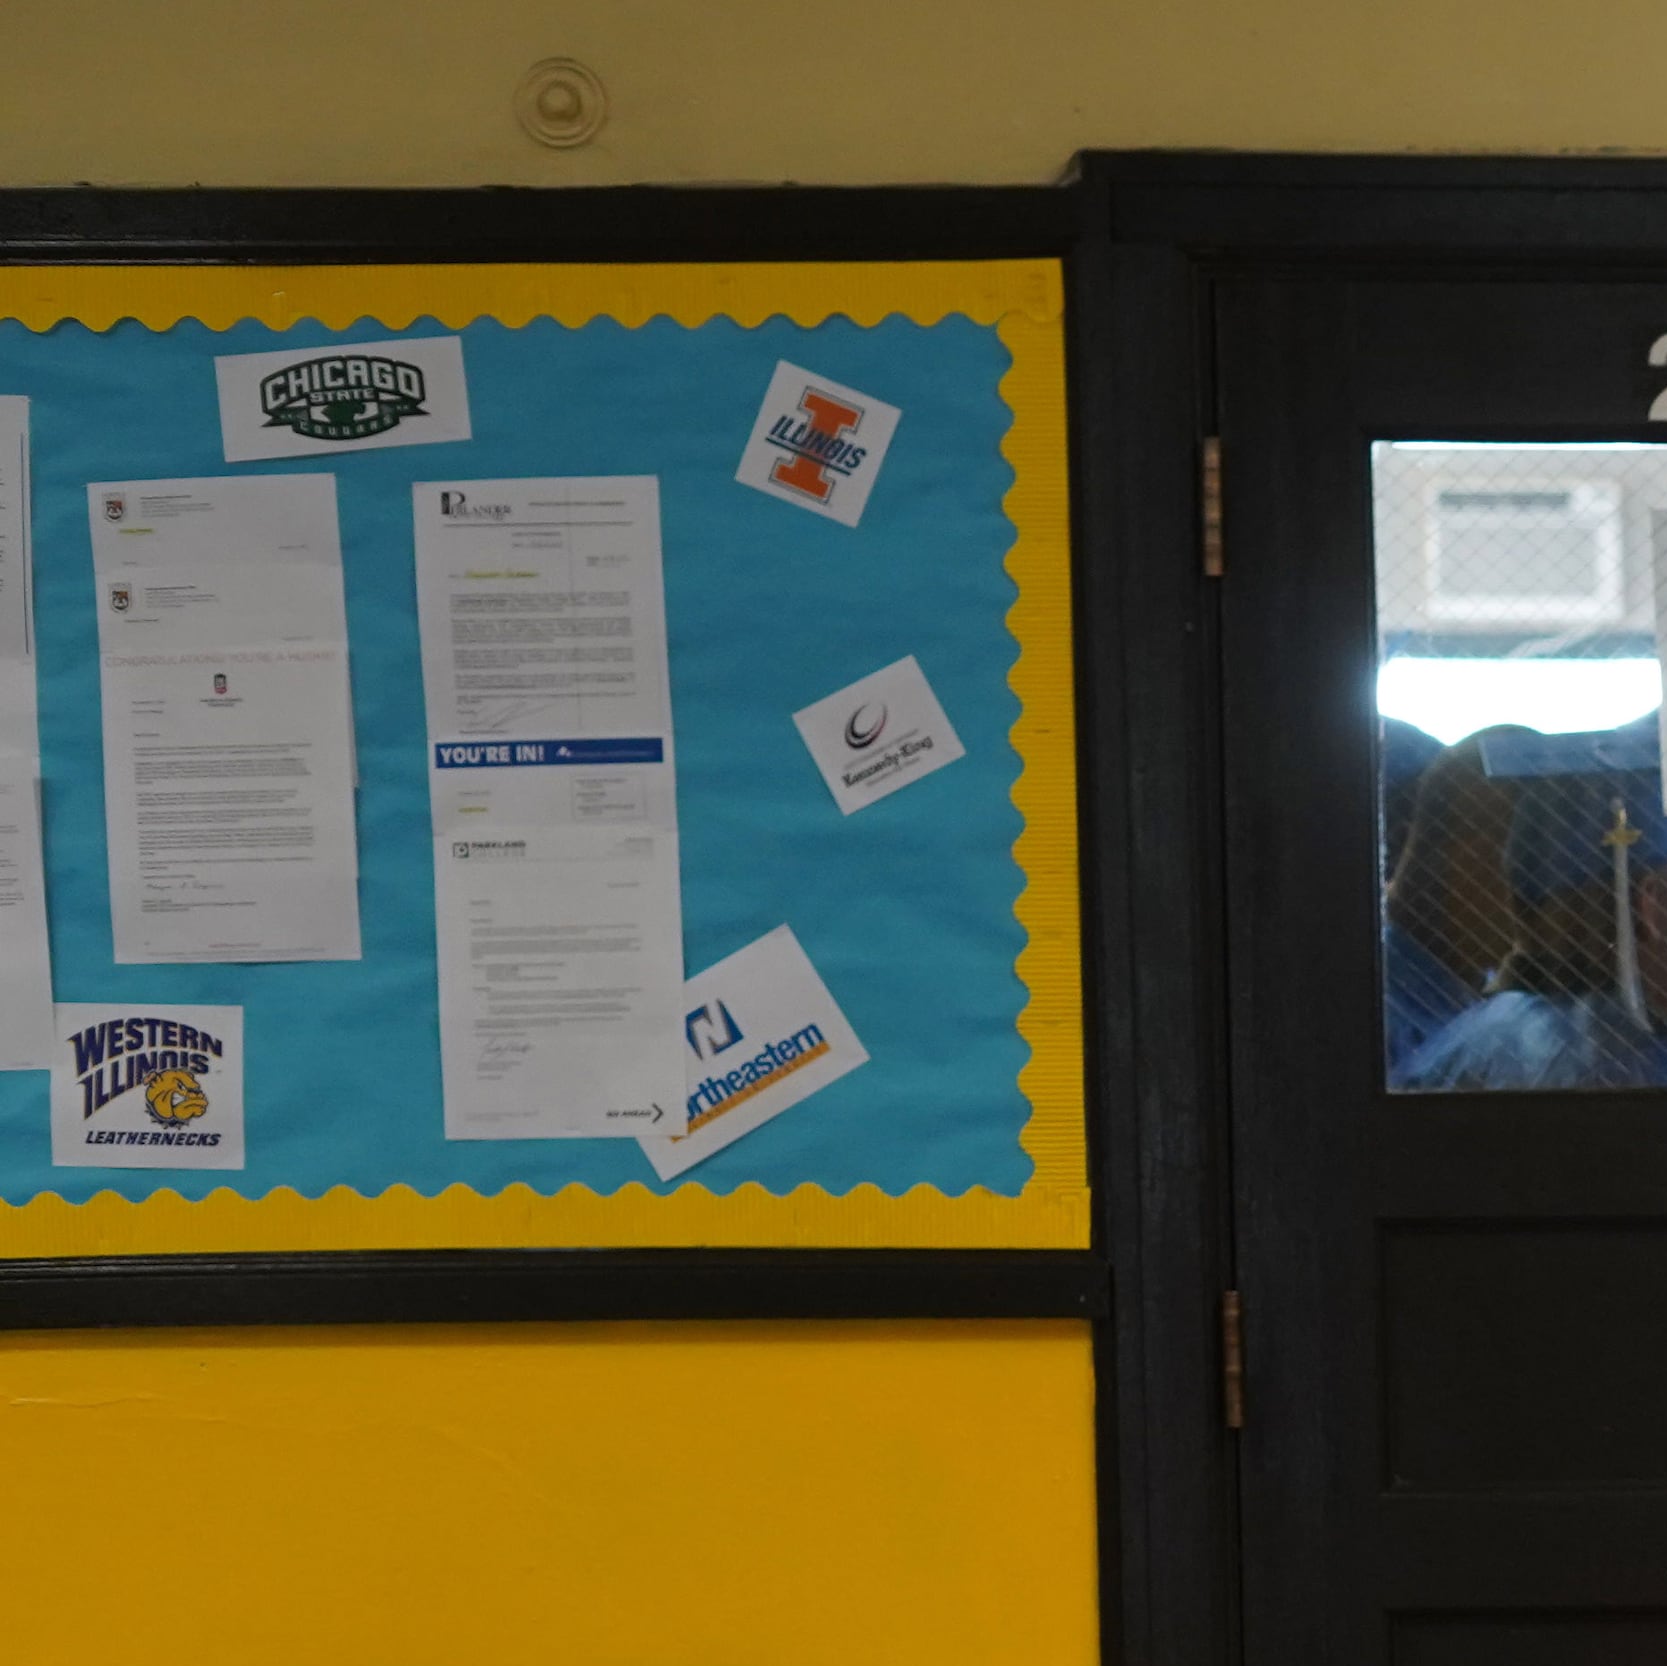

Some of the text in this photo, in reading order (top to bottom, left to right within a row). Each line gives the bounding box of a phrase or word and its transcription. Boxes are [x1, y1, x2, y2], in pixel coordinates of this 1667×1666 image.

[264, 358, 421, 411] CHICAGO
[309, 387, 375, 405] STATE
[769, 415, 867, 470] ILLINOIS
[440, 746, 511, 764] YOU'RE
[515, 745, 545, 762] IN!
[67, 1017, 222, 1077] WESTERN
[76, 1050, 209, 1121] ILLINOIS
[86, 1130, 222, 1147] LEATHERNECKS
